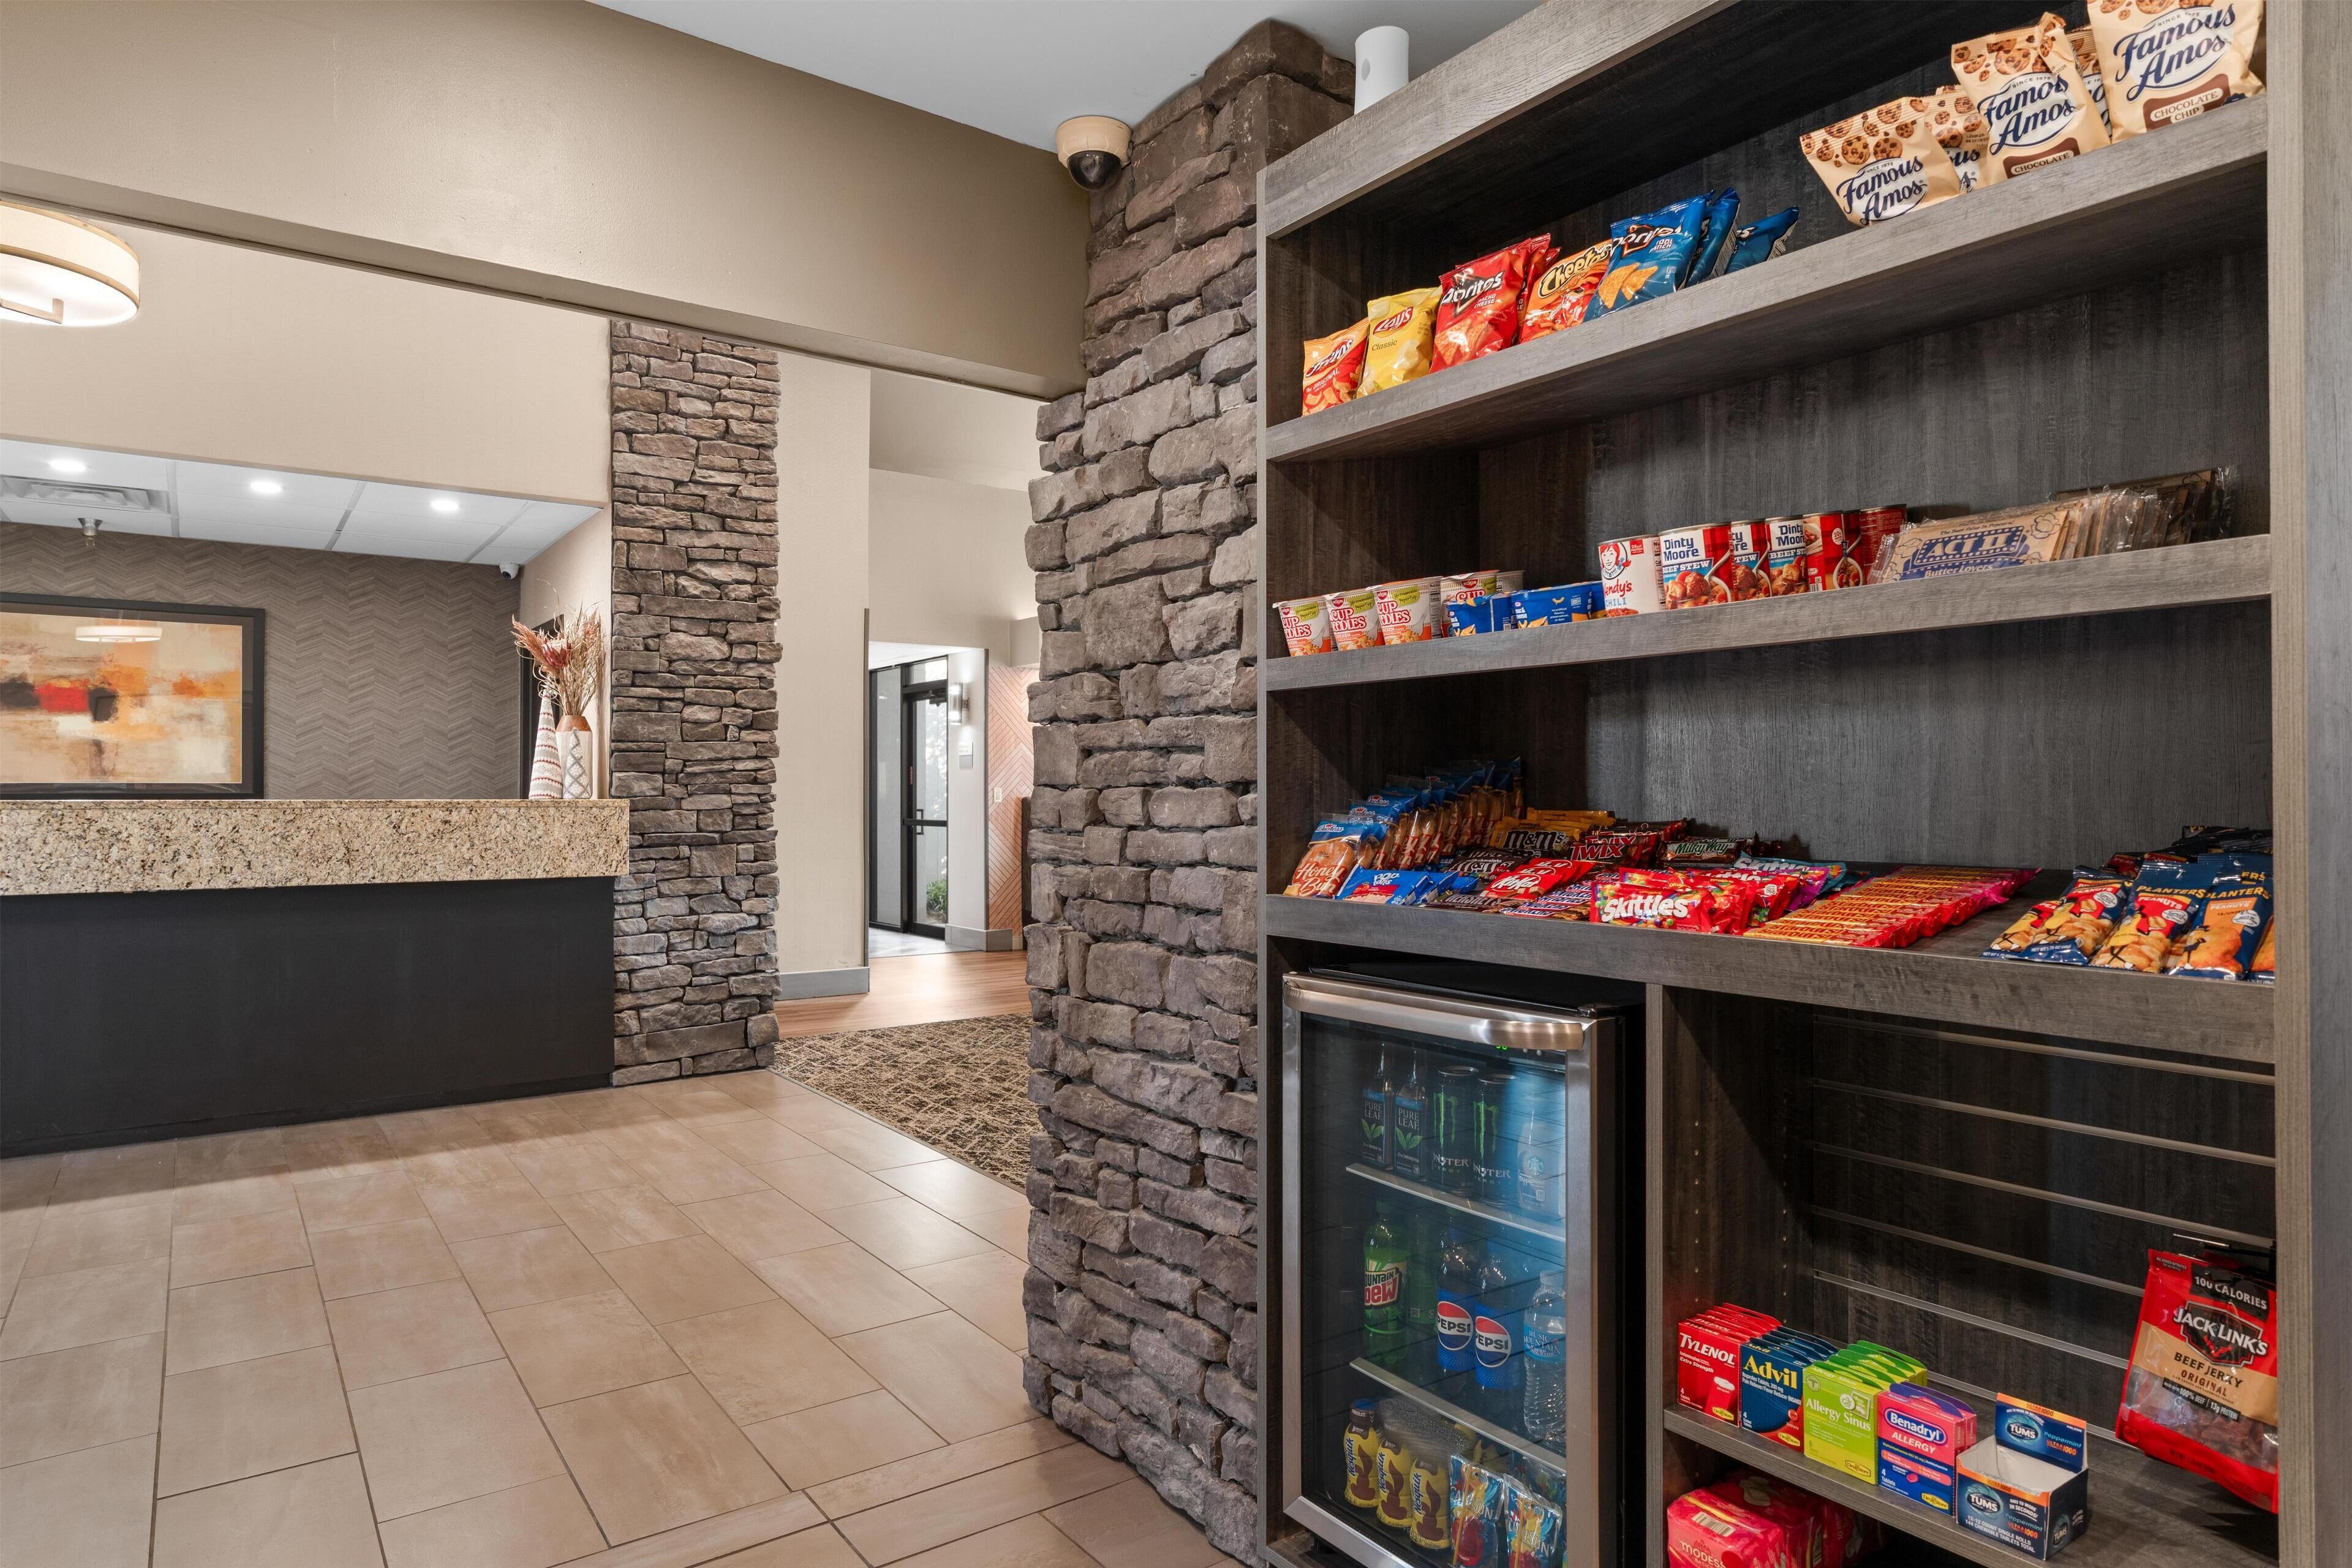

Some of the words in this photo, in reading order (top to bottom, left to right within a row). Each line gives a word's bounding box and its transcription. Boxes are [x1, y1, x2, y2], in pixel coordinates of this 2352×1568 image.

[2157, 14, 2181, 26] SINCE
[2113, 4, 2236, 83] Famous
[2127, 35, 2231, 102] Amos
[2012, 77, 2034, 88] SINCE
[2154, 91, 2218, 119] CHOCOLATE
[2174, 107, 2199, 121] CHIP
[1989, 99, 2076, 156] Amos
[2014, 153, 2070, 173] CHOCOLATE
[1836, 156, 1924, 214] Famous
[1860, 180, 1928, 225] Amos
[1441, 271, 1505, 306] Doritos
[1374, 307, 1412, 333] Lay's
[1371, 339, 1398, 351] Classic
[1313, 367, 1340, 390] ORIGINAL
[1778, 524, 1804, 535] Dinty
[1664, 537, 1694, 550] Dinty
[1925, 537, 1979, 557] ACT
[1978, 532, 2012, 551] II
[1664, 548, 1699, 562] Moore
[1769, 549, 1796, 559] BEEF
[1679, 559, 1710, 572] STEW
[1924, 566, 1959, 578] Butter
[1959, 564, 1994, 573] Lovers
[1605, 578, 1632, 598] endy's
[1330, 608, 1354, 622] CUP
[1377, 601, 1398, 614] CUP
[1570, 844, 1626, 861] TWIX
[1675, 842, 1704, 856] Milky
[1705, 842, 1729, 854] Way
[1295, 862, 1345, 883] Honey
[1298, 876, 1337, 897] Bun
[2136, 885, 2206, 899] PLANTERS
[1602, 895, 1689, 922] Skittles
[2138, 896, 2183, 910] PEANUTS
[2210, 902, 2250, 911] PEANUTS
[1364, 1109, 1382, 1120] LEAF
[1365, 1100, 1382, 1112] PURE
[1398, 1107, 1419, 1121] PURE
[1398, 1117, 1419, 1129] LEAF
[2214, 1283, 2267, 1310] CALORIES
[1436, 1316, 1471, 1333] PEPSI
[2173, 1308, 2217, 1337] JACK
[2218, 1324, 2268, 1355] LINK'S
[1529, 1330, 1549, 1343] MUSIC
[1679, 1332, 1736, 1366] TYLENOL
[1679, 1356, 1692, 1365] Extra
[1692, 1360, 1714, 1373] Strength
[1743, 1355, 1798, 1390] Advil
[1812, 1366, 1837, 1378] Allergy
[2174, 1351, 2205, 1371] BEEF
[2204, 1365, 2244, 1388] JERKY
[1742, 1371, 1757, 1382] Ibuprofen
[1757, 1378, 1771, 1387] Tablets,
[2181, 1370, 2227, 1397] ORIGINAL
[1773, 1389, 1788, 1400] Reducer
[2180, 1387, 2195, 1400] 100%
[2195, 1395, 2206, 1404] BEEF
[1351, 1409, 1366, 1417] CHOCOLATE
[1806, 1398, 1841, 1422] Allergy
[1843, 1412, 1871, 1431] Sinus
[2041, 1408, 2054, 1417] 1000
[2210, 1401, 2220, 1413] 13g
[2220, 1406, 2239, 1420] PROTEIN
[1890, 1412, 1942, 1441] Benadryl
[2010, 1424, 2036, 1439] TUMS
[1891, 1431, 1936, 1453] ALLERGY
[2044, 1431, 2082, 1449] Peppermint
[1346, 1437, 1355, 1477] Nesquik
[2062, 1446, 2076, 1456] 1000
[1378, 1450, 1387, 1493] Nesquik
[1881, 1476, 1896, 1487] Tablets
[2000, 1483, 2011, 1492] 1000
[1414, 1472, 1422, 1515] Nesquik
[1970, 1494, 1998, 1512] TUMS
[2024, 1502, 2037, 1511] WORK
[2015, 1505, 2038, 1519] SECONDS!
[1967, 1515, 1981, 1525] 12-12
[1981, 1520, 1997, 1531] COUNT
[1998, 1526, 2015, 1539] SINGLE
[2015, 1534, 2032, 1545] ROLLS
[2005, 1513, 2043, 1532] Peppermint
[1974, 1523, 1999, 1537] CHEWABLE
[1999, 1531, 2020, 1546] TABLETS
[2021, 1539, 2036, 1553] TOTAL
[2024, 1528, 2038, 1539] 1000
[2054, 1528, 2068, 1540] TUMS
